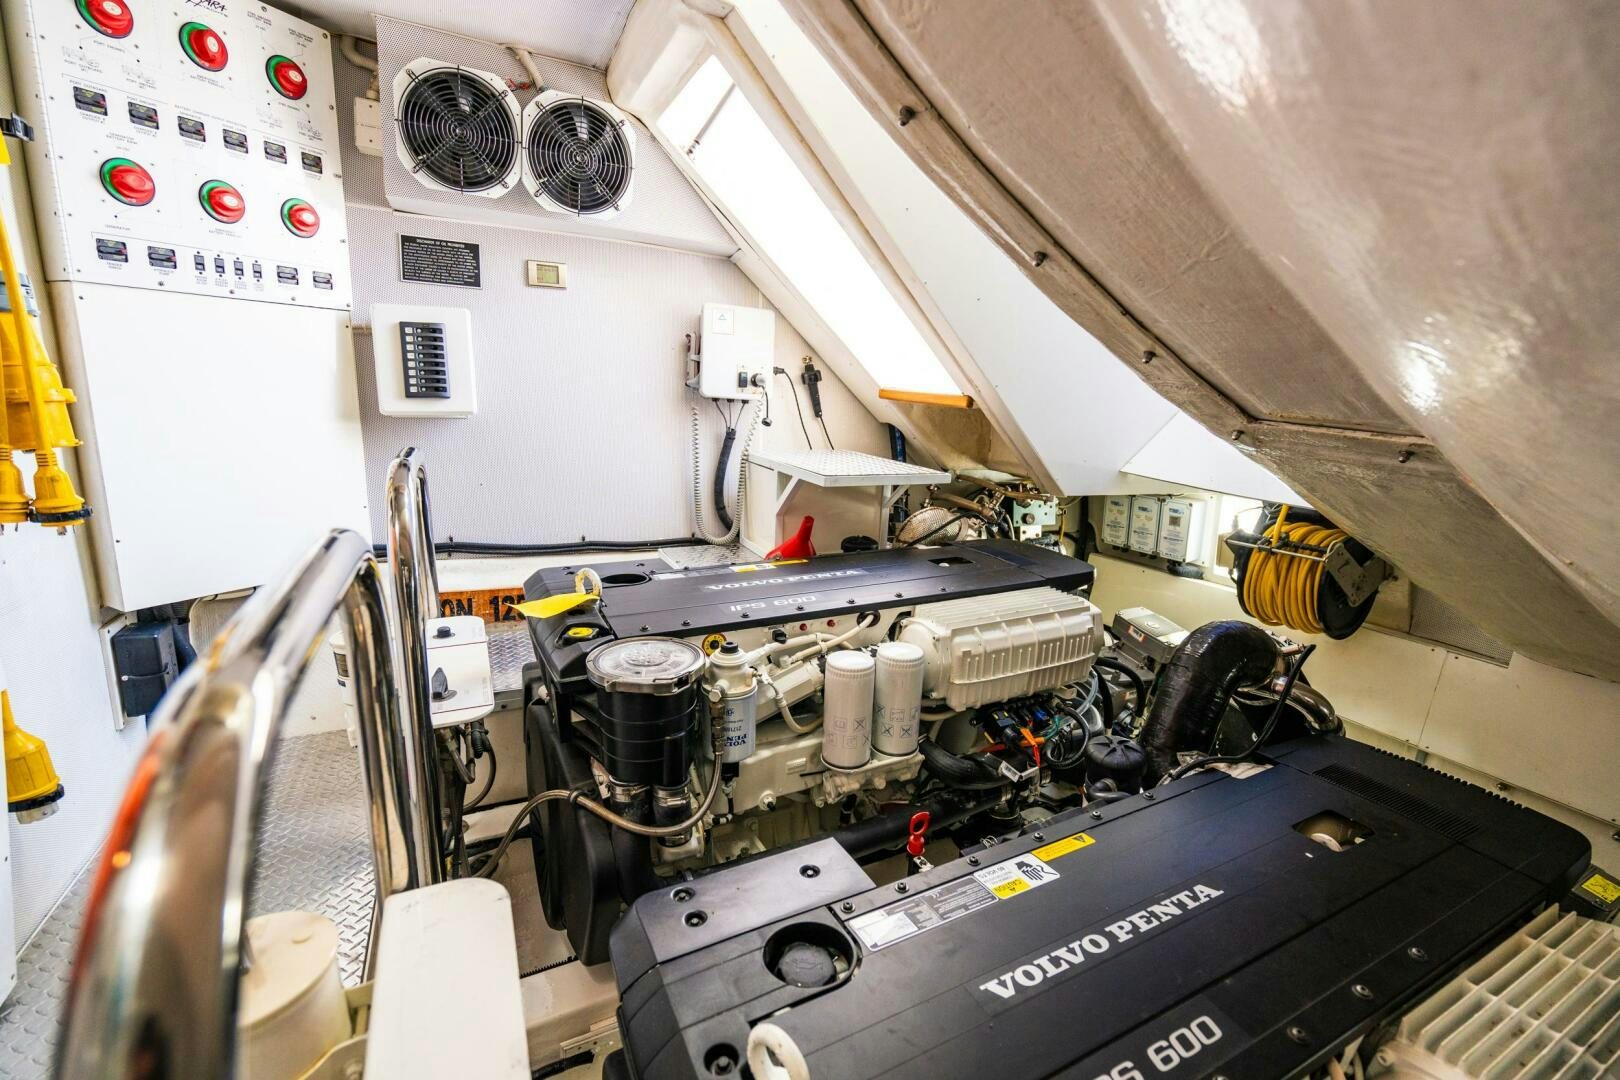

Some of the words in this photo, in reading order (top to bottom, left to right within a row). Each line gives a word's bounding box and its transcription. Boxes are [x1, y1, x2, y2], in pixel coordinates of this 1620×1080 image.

[706, 577, 783, 590] VOLVO
[787, 569, 860, 582] PENTA
[729, 602, 767, 612] IPS
[773, 594, 817, 606] 600
[979, 934, 1110, 999] VOLVO
[1104, 883, 1225, 944] PENTA
[1147, 1015, 1223, 1073] 600
